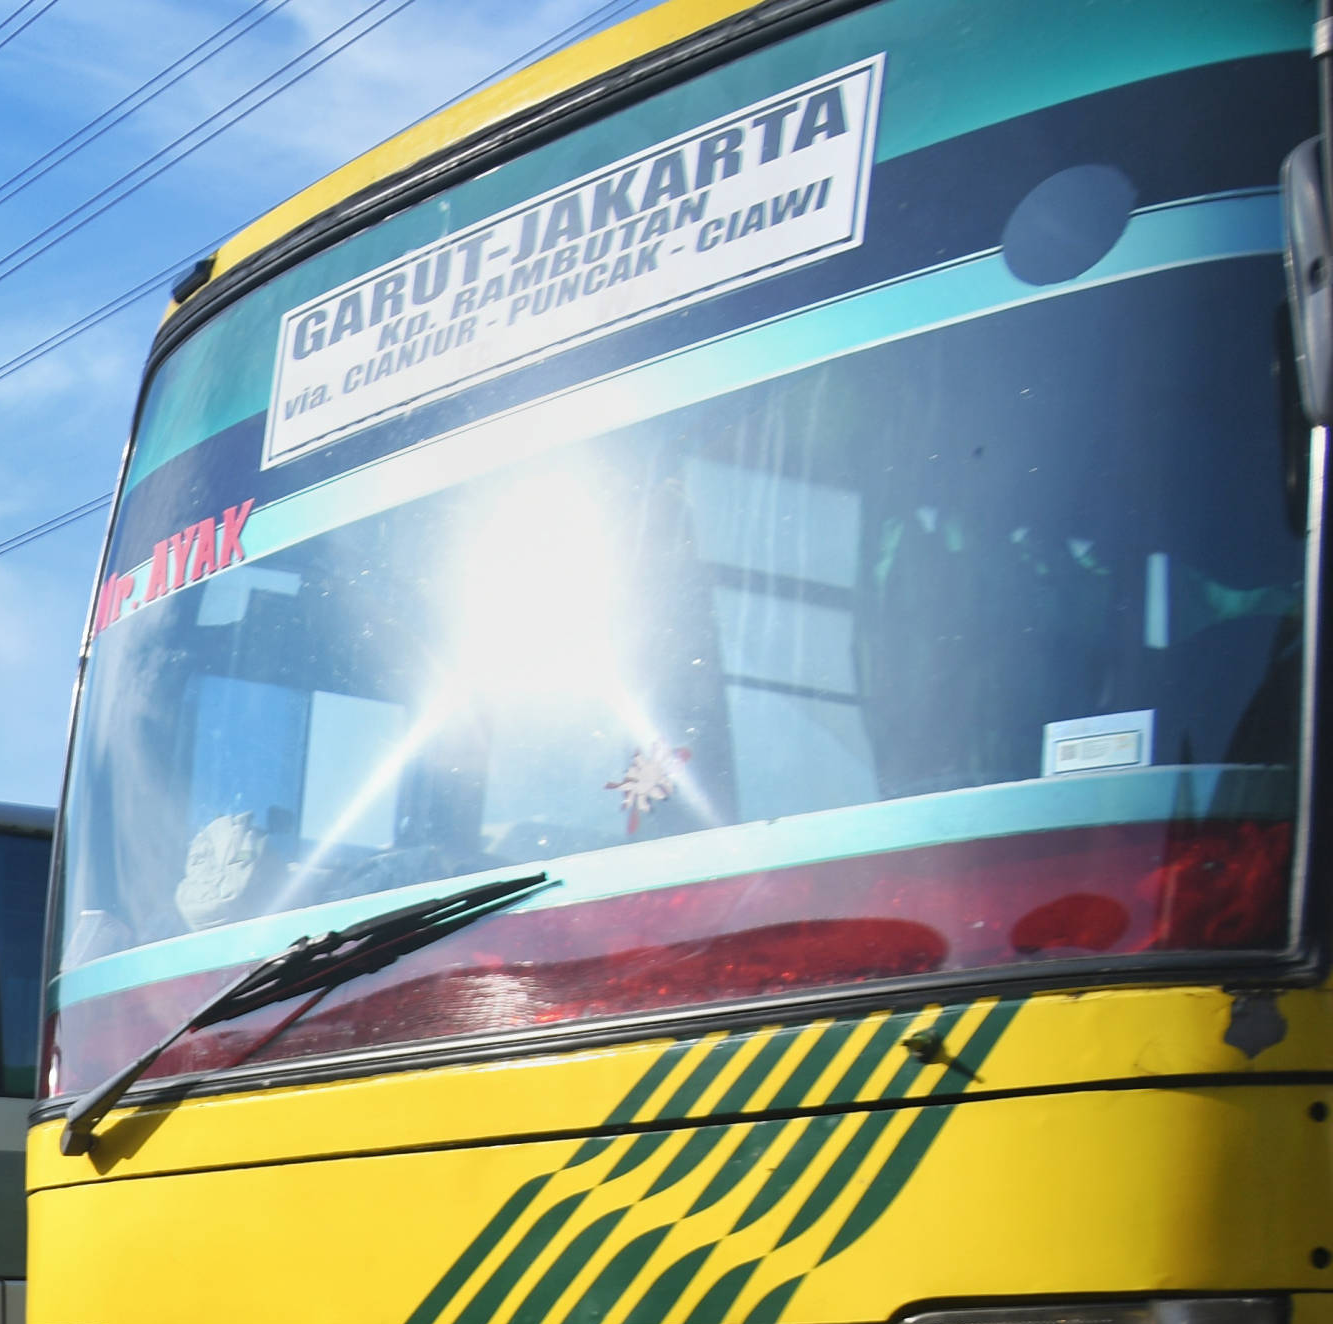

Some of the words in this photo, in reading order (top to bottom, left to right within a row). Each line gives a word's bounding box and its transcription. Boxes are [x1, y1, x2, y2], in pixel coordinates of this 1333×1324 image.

[284, 383, 332, 422] via.
[342, 315, 479, 395] CIANJUR
[507, 239, 665, 327] PUNCAK
[695, 175, 835, 254] CIAWI
[292, 84, 849, 361] GARUT-JAKARTA
[376, 311, 437, 352] Kp.
[450, 189, 712, 322] RAMBUTAN
[144, 497, 256, 603] AYAK
